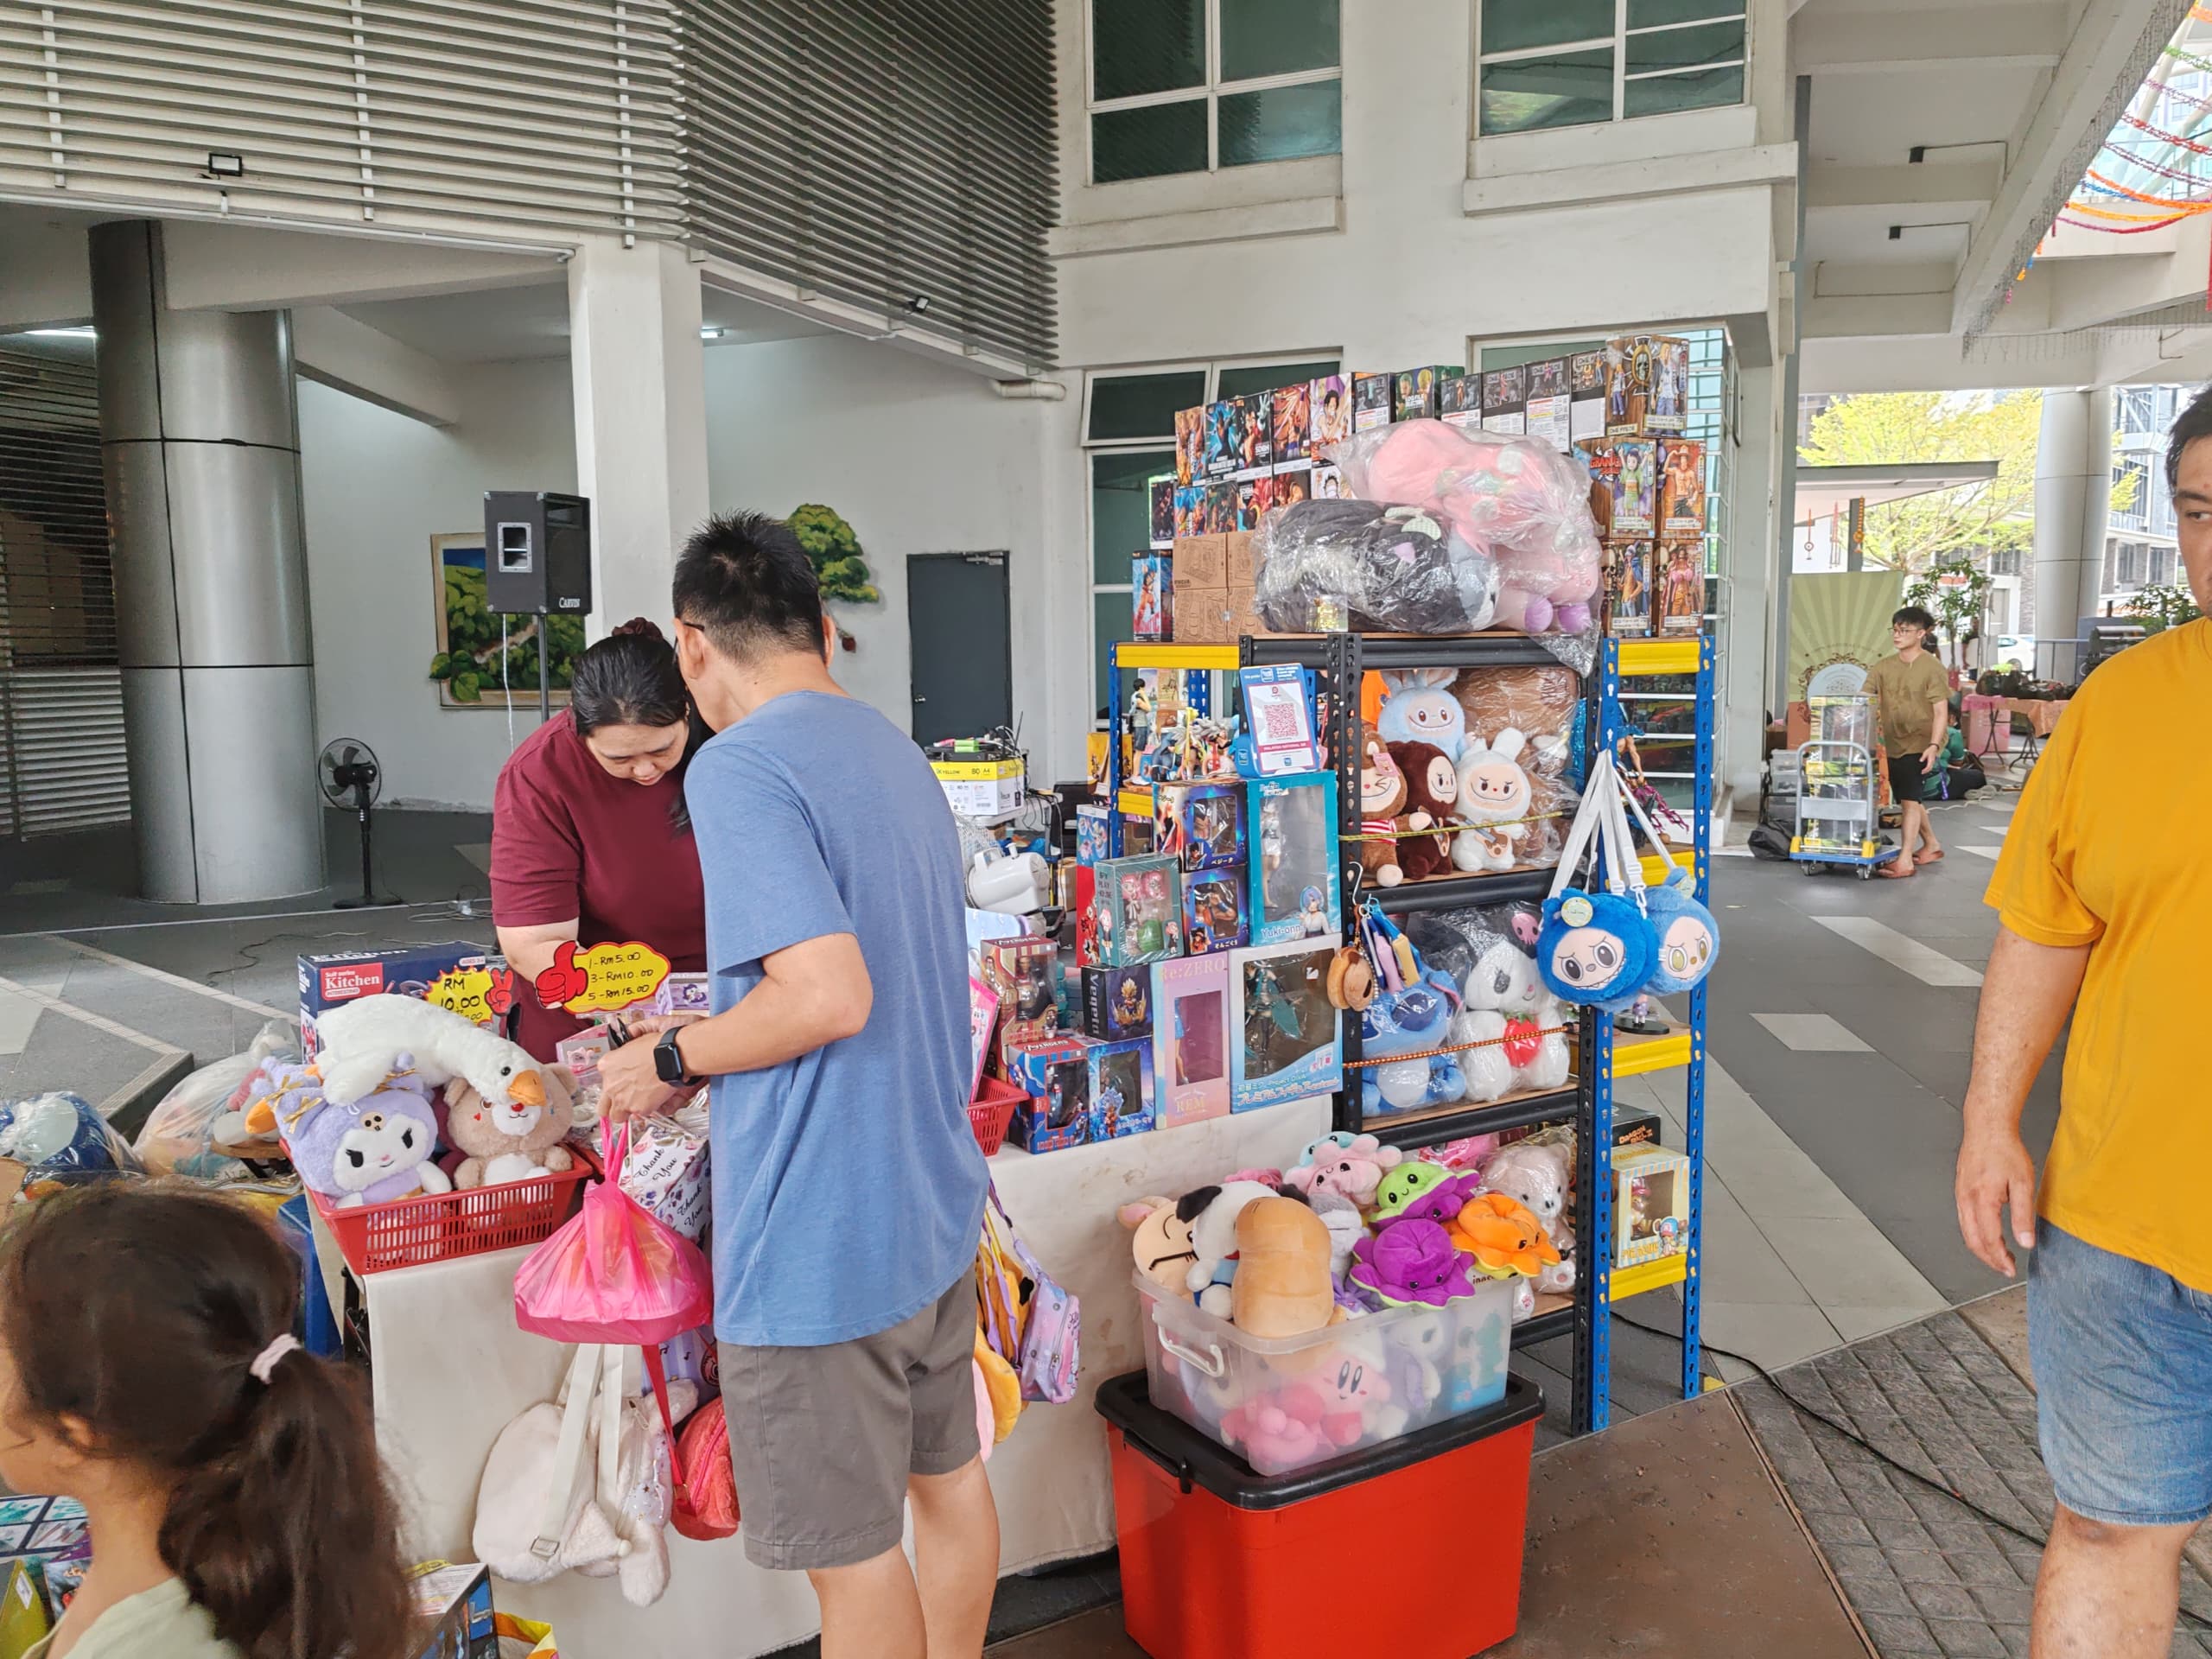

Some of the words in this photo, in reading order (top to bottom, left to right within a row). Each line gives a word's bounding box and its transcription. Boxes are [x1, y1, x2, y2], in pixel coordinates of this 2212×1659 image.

[1261, 925, 1301, 939] Yuki-onn
[325, 975, 380, 990] Kitchen
[443, 977, 465, 991] RM
[633, 1147, 664, 1179] Thank
[652, 1157, 677, 1182] You
